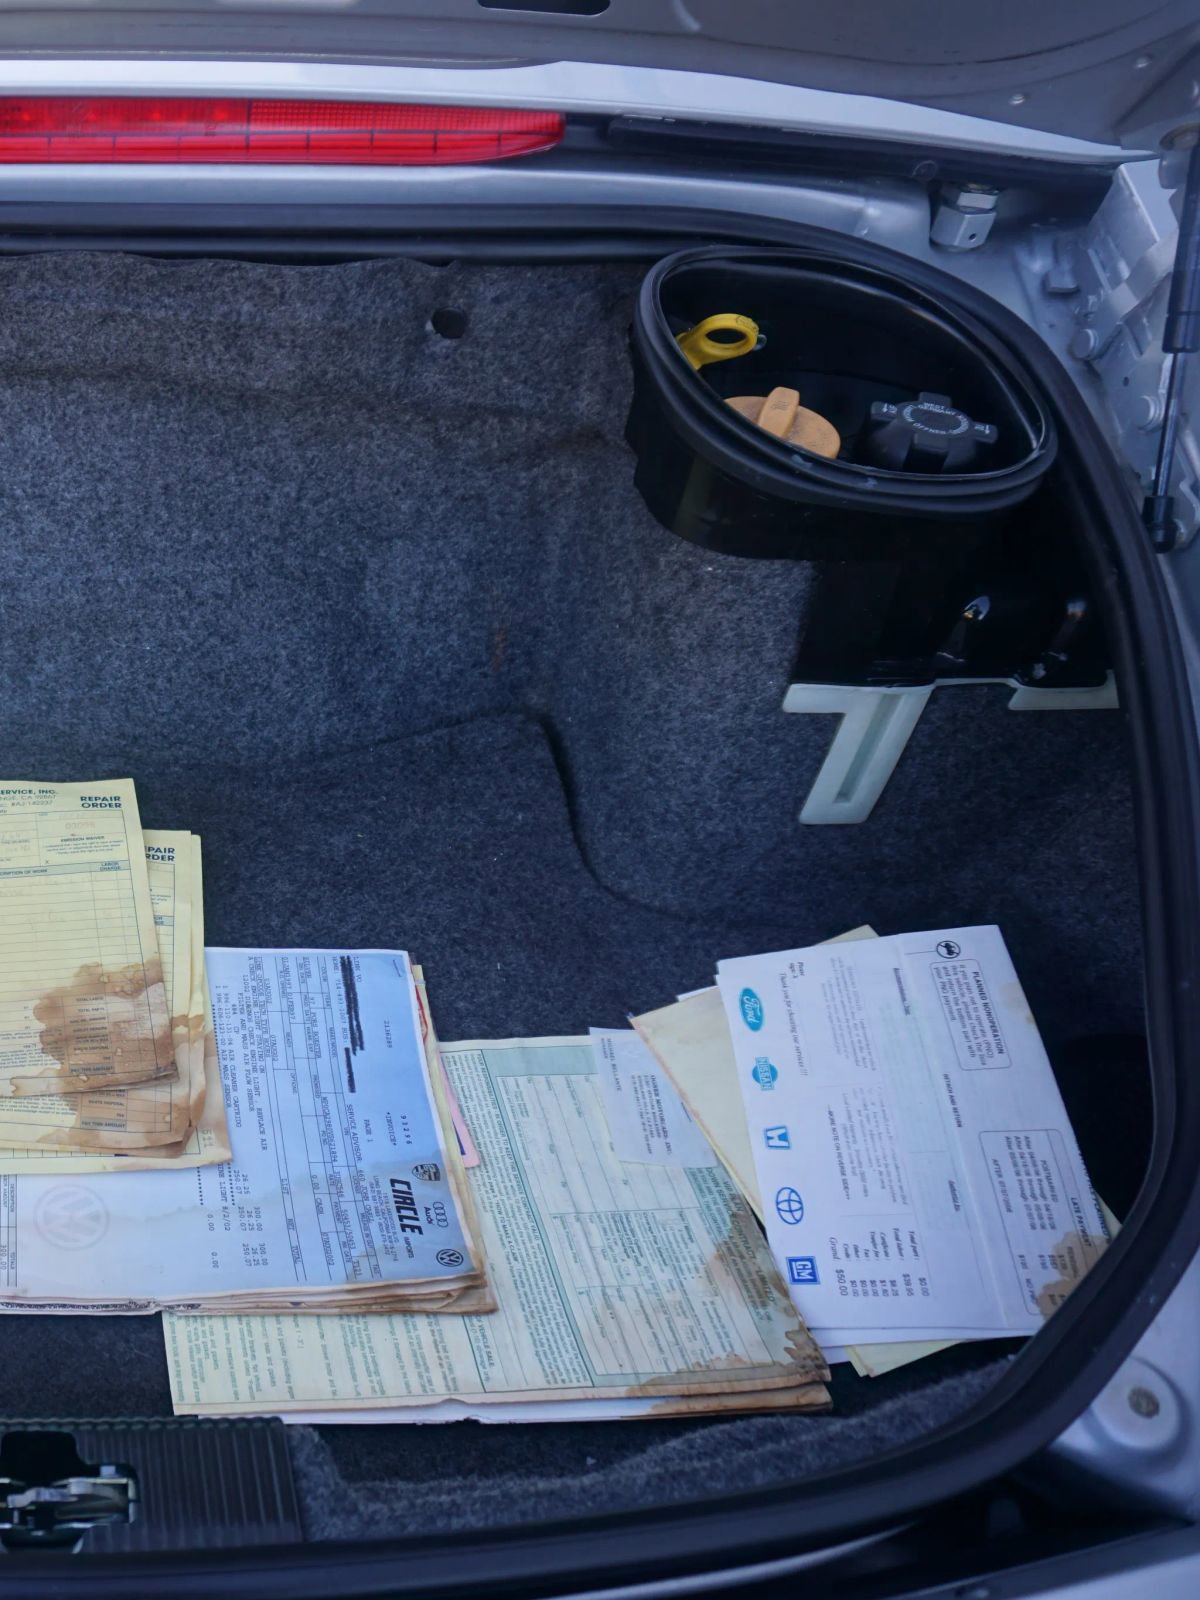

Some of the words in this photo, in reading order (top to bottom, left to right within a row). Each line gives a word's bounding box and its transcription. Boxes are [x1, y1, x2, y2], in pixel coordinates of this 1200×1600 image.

[144, 846, 175, 854] PAIR
[146, 854, 175, 862] RDER
[249, 964, 257, 982] CHECK
[251, 985, 259, 1008] ENGINE
[963, 982, 973, 995] plan
[743, 996, 759, 1023] Ford
[972, 972, 987, 1001] PLANNED
[983, 1002, 1005, 1054] NONOPERATION
[247, 1027, 255, 1046] CHECK
[255, 1034, 263, 1062] STAYING
[249, 1050, 257, 1073] ENGINE
[967, 1045, 976, 1058] with
[230, 1065, 238, 1092] CLEANER
[260, 1065, 265, 1073] ON
[755, 1057, 774, 1091] NISSAN
[243, 1053, 251, 1066] AIR
[247, 1088, 255, 1112] SENSOR
[252, 1076, 260, 1096] LIGHT
[224, 1083, 232, 1108] SENSOR
[233, 1096, 242, 1128] CARTRIDG
[256, 1108, 265, 1135] REPLACE
[347, 1104, 357, 1129] SERVICE
[952, 1107, 962, 1128] RETURN
[992, 1159, 1003, 1178] AFTER
[233, 1170, 242, 1194] 250.07
[723, 1181, 733, 1192] VIP
[389, 1178, 423, 1235] CIRCLE
[423, 1207, 433, 1224] Audi
[237, 1206, 246, 1231] 250.07
[254, 1206, 263, 1231] 300.00
[717, 1190, 737, 1218] SERVICE
[733, 1221, 756, 1259] CONTRACT
[1070, 1197, 1082, 1213] LATE
[1076, 1216, 1092, 1247] PAYMENT
[246, 1210, 255, 1231] 26.25
[251, 1247, 259, 1266] 26.25
[501, 1224, 511, 1240] MAKE
[211, 1252, 219, 1269] 0.00
[242, 1243, 251, 1267] 250.07
[259, 1243, 268, 1266] 300.00
[292, 1246, 300, 1265] TOTAL
[796, 1262, 814, 1279] GM
[835, 1269, 849, 1296] $50.00
[850, 1280, 859, 1296] $0.00
[860, 1280, 869, 1296] $0.00
[869, 1280, 879, 1296] $0.00
[918, 1277, 930, 1296] $0.00
[478, 1325, 489, 1349] VEHICLE
